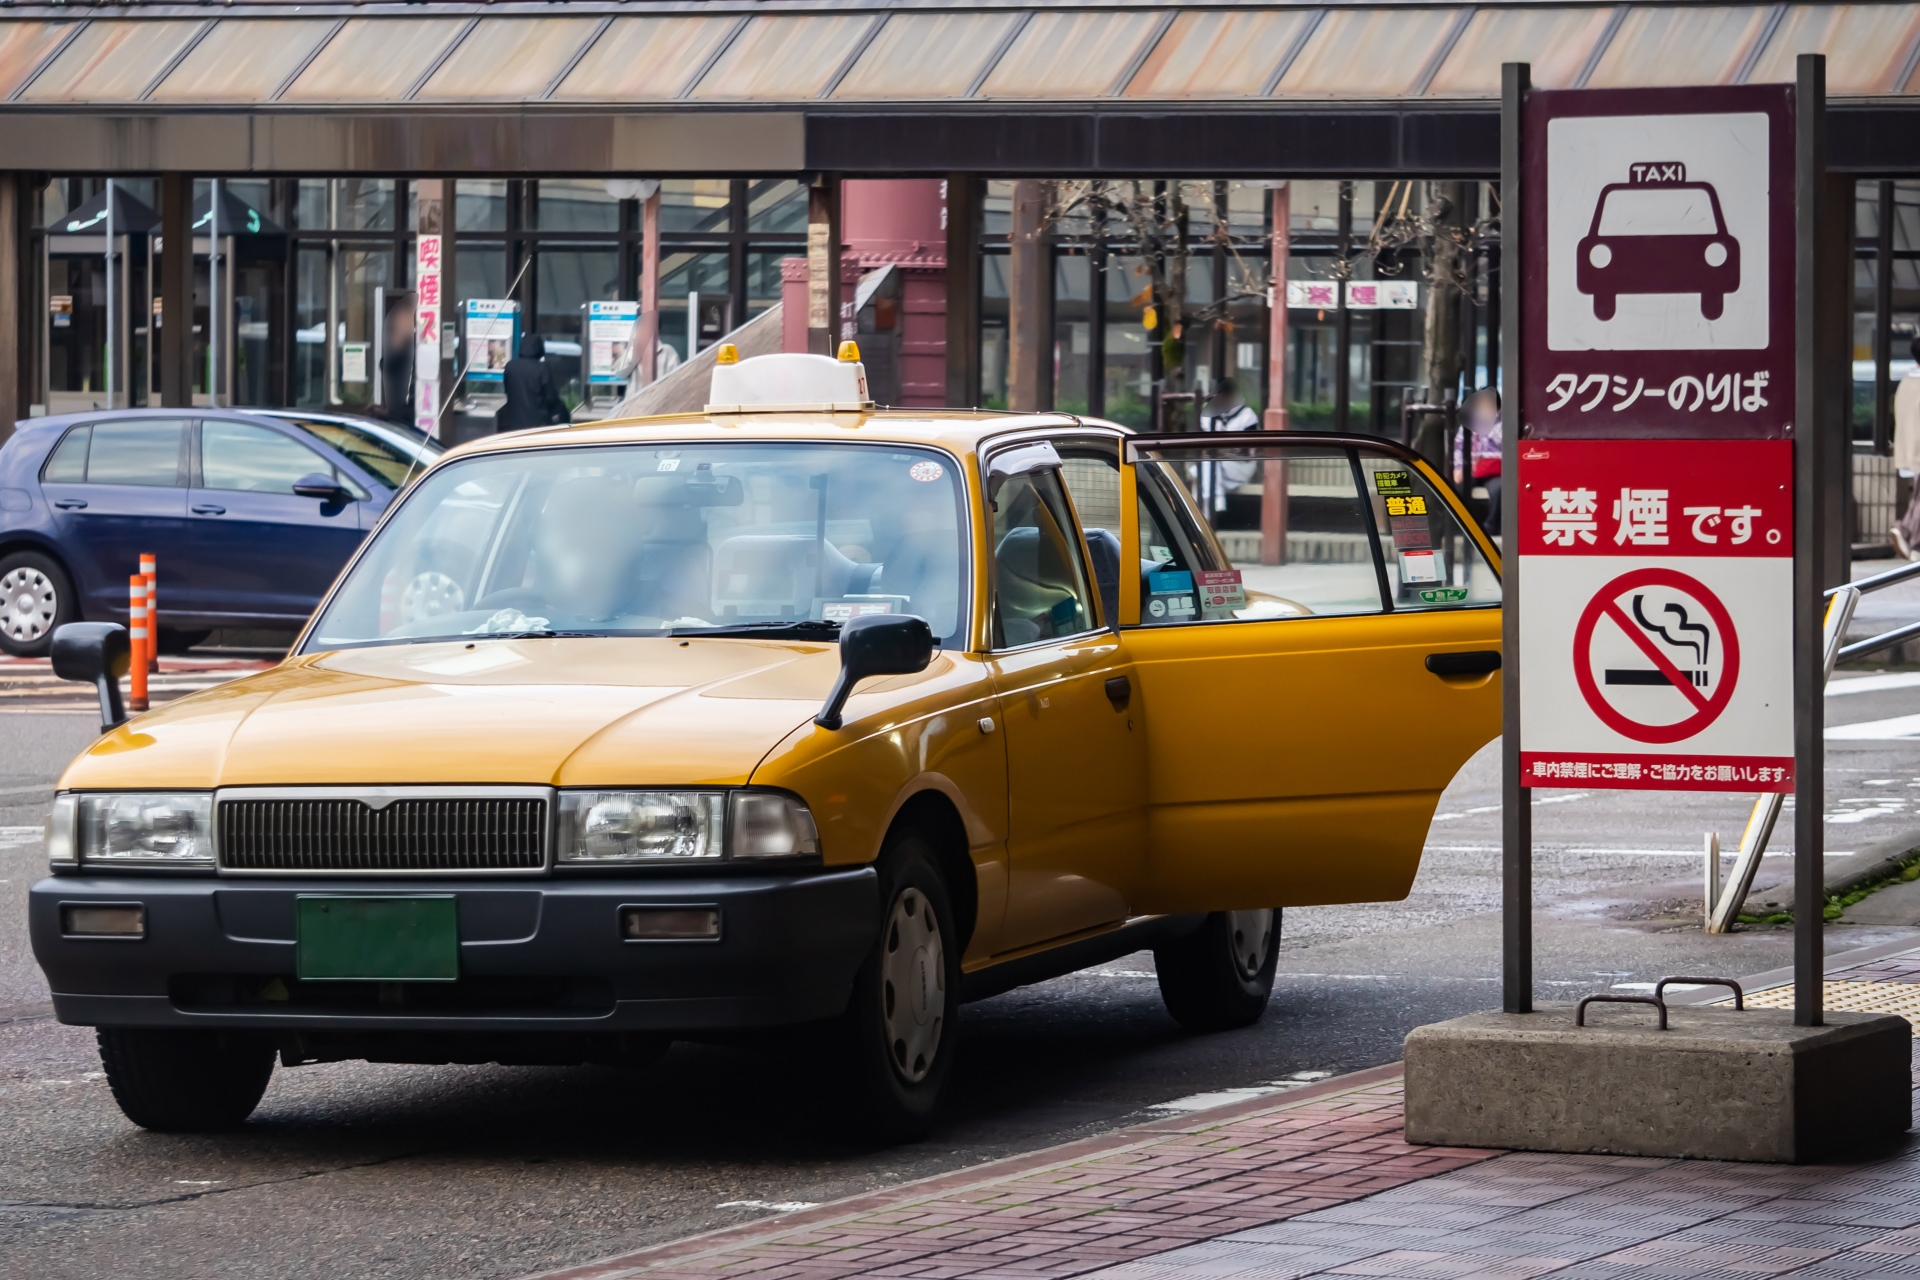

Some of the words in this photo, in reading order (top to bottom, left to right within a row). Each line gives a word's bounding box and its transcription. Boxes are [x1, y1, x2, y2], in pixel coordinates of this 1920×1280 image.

[1632, 165, 1683, 183] TAXI
[1545, 370, 1770, 412] タクシーのりば
[1386, 497, 1427, 515] 普通
[1540, 487, 1782, 547] 禁煙です。
[1532, 760, 1786, 783] 車内禁煙にご理解・ご協力をお願いします
